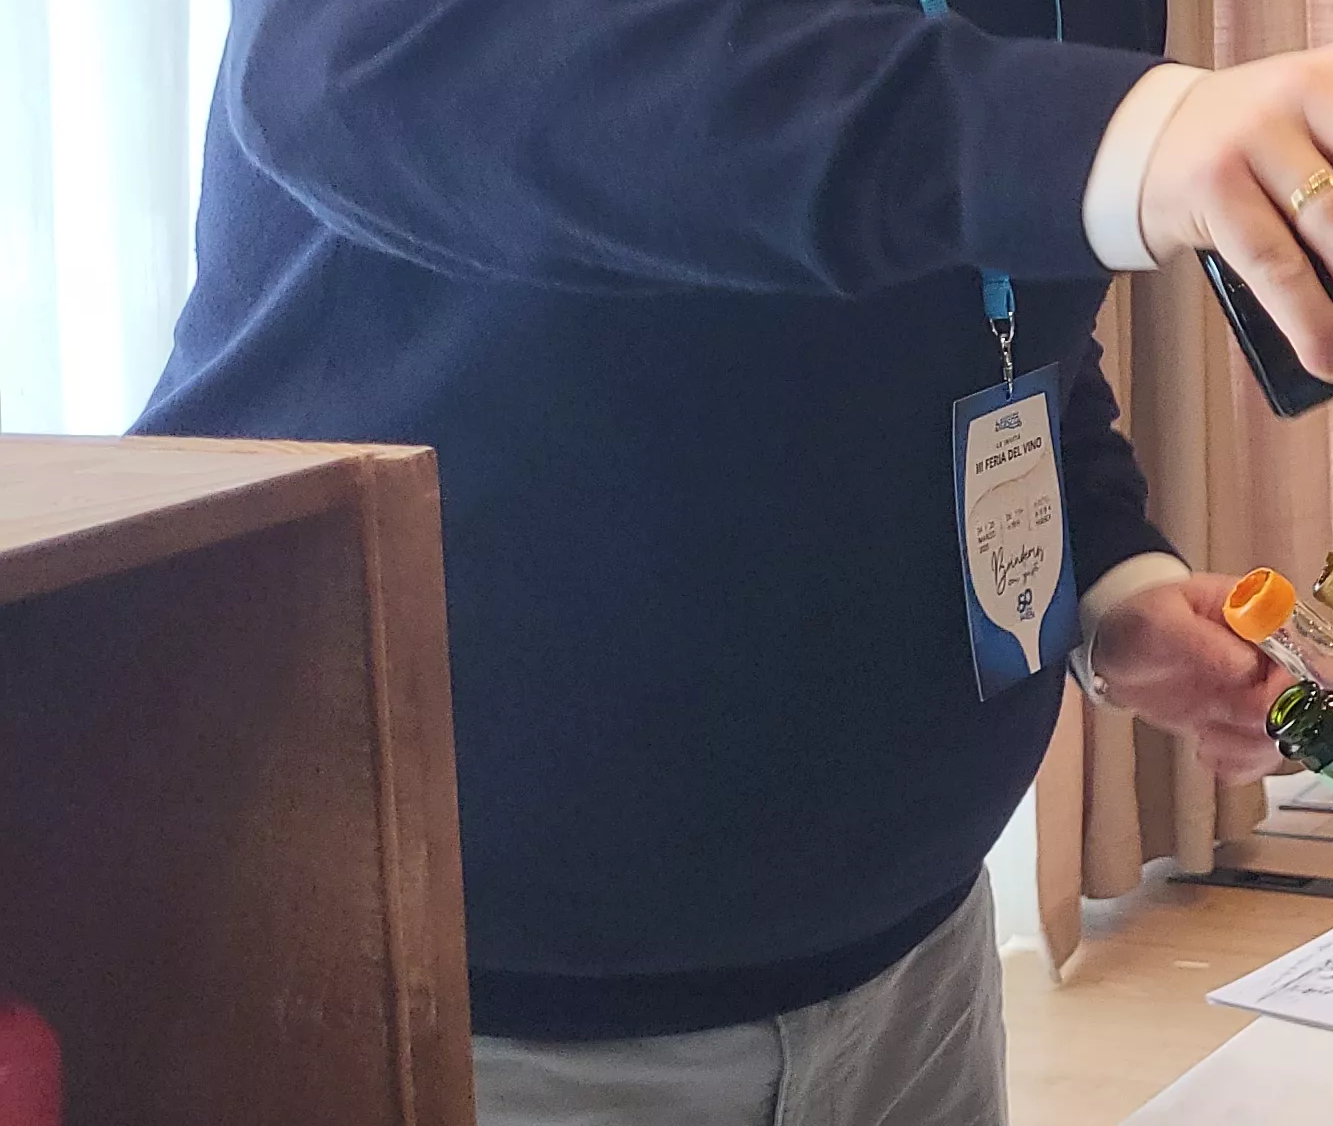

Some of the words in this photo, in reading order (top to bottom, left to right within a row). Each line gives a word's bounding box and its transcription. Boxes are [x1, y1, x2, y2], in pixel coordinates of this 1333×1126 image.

[985, 452, 1007, 469] FERIA
[1008, 445, 1022, 461] DEL
[1023, 437, 1042, 454] VINO
